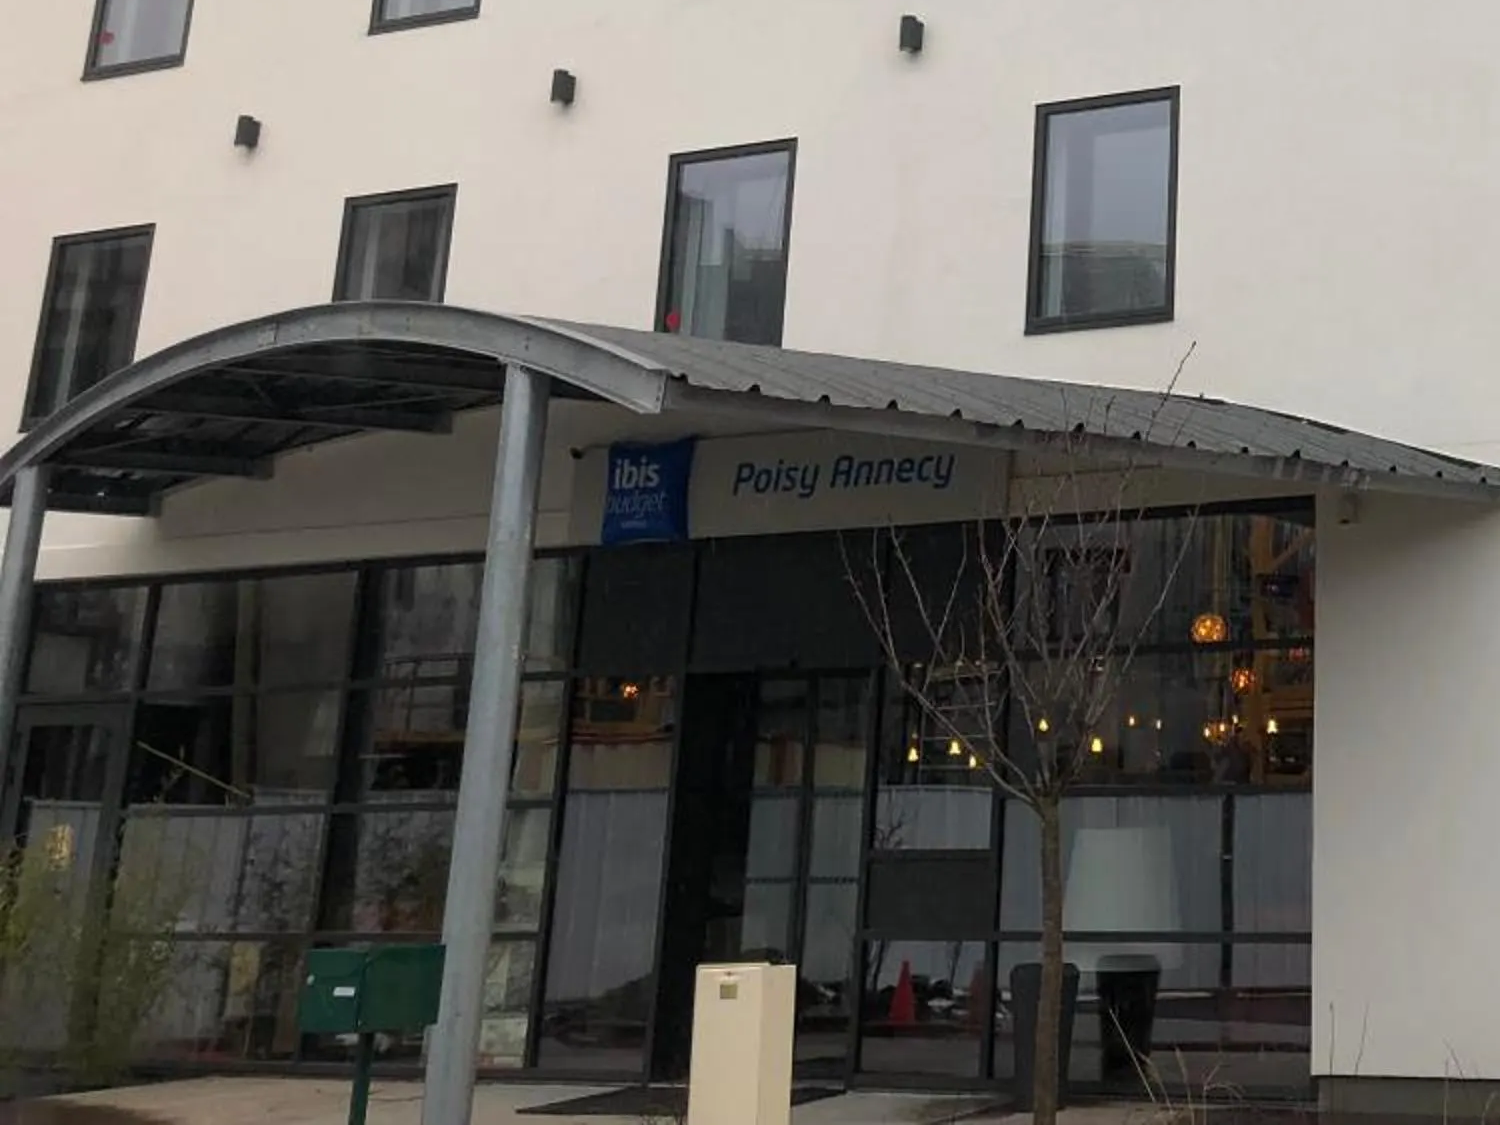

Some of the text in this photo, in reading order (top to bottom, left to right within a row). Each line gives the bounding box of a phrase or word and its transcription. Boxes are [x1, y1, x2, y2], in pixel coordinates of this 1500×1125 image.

[613, 455, 661, 489] ibis
[733, 454, 955, 498] Poisy Annecy
[605, 490, 669, 518] budget
